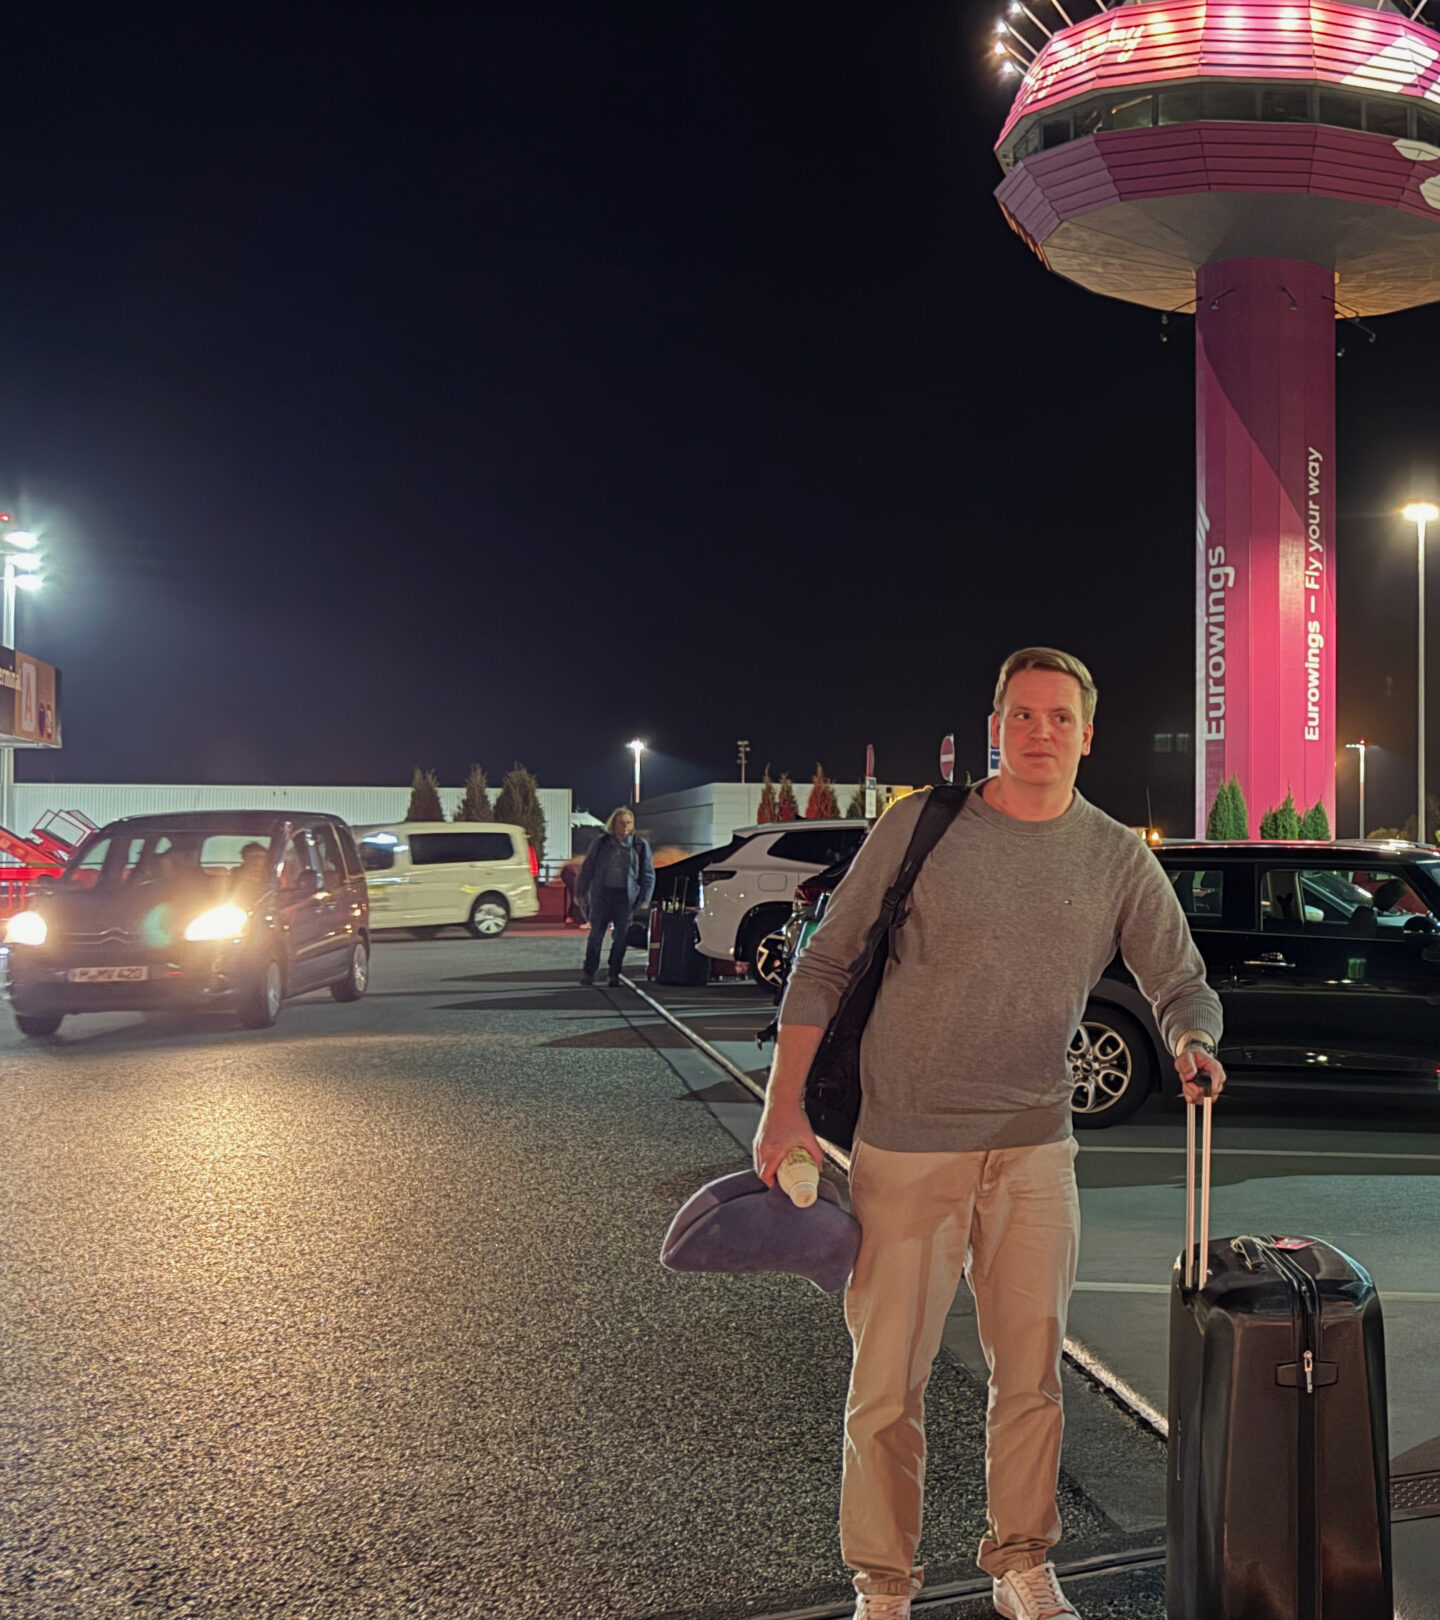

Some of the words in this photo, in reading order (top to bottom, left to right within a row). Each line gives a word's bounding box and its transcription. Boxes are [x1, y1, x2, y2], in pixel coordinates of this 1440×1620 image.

[1307, 446, 1324, 496] way
[1308, 500, 1324, 553] your
[1304, 556, 1324, 590] Fly
[1203, 545, 1236, 741] Eurowings
[1305, 619, 1325, 741] Eurowings
